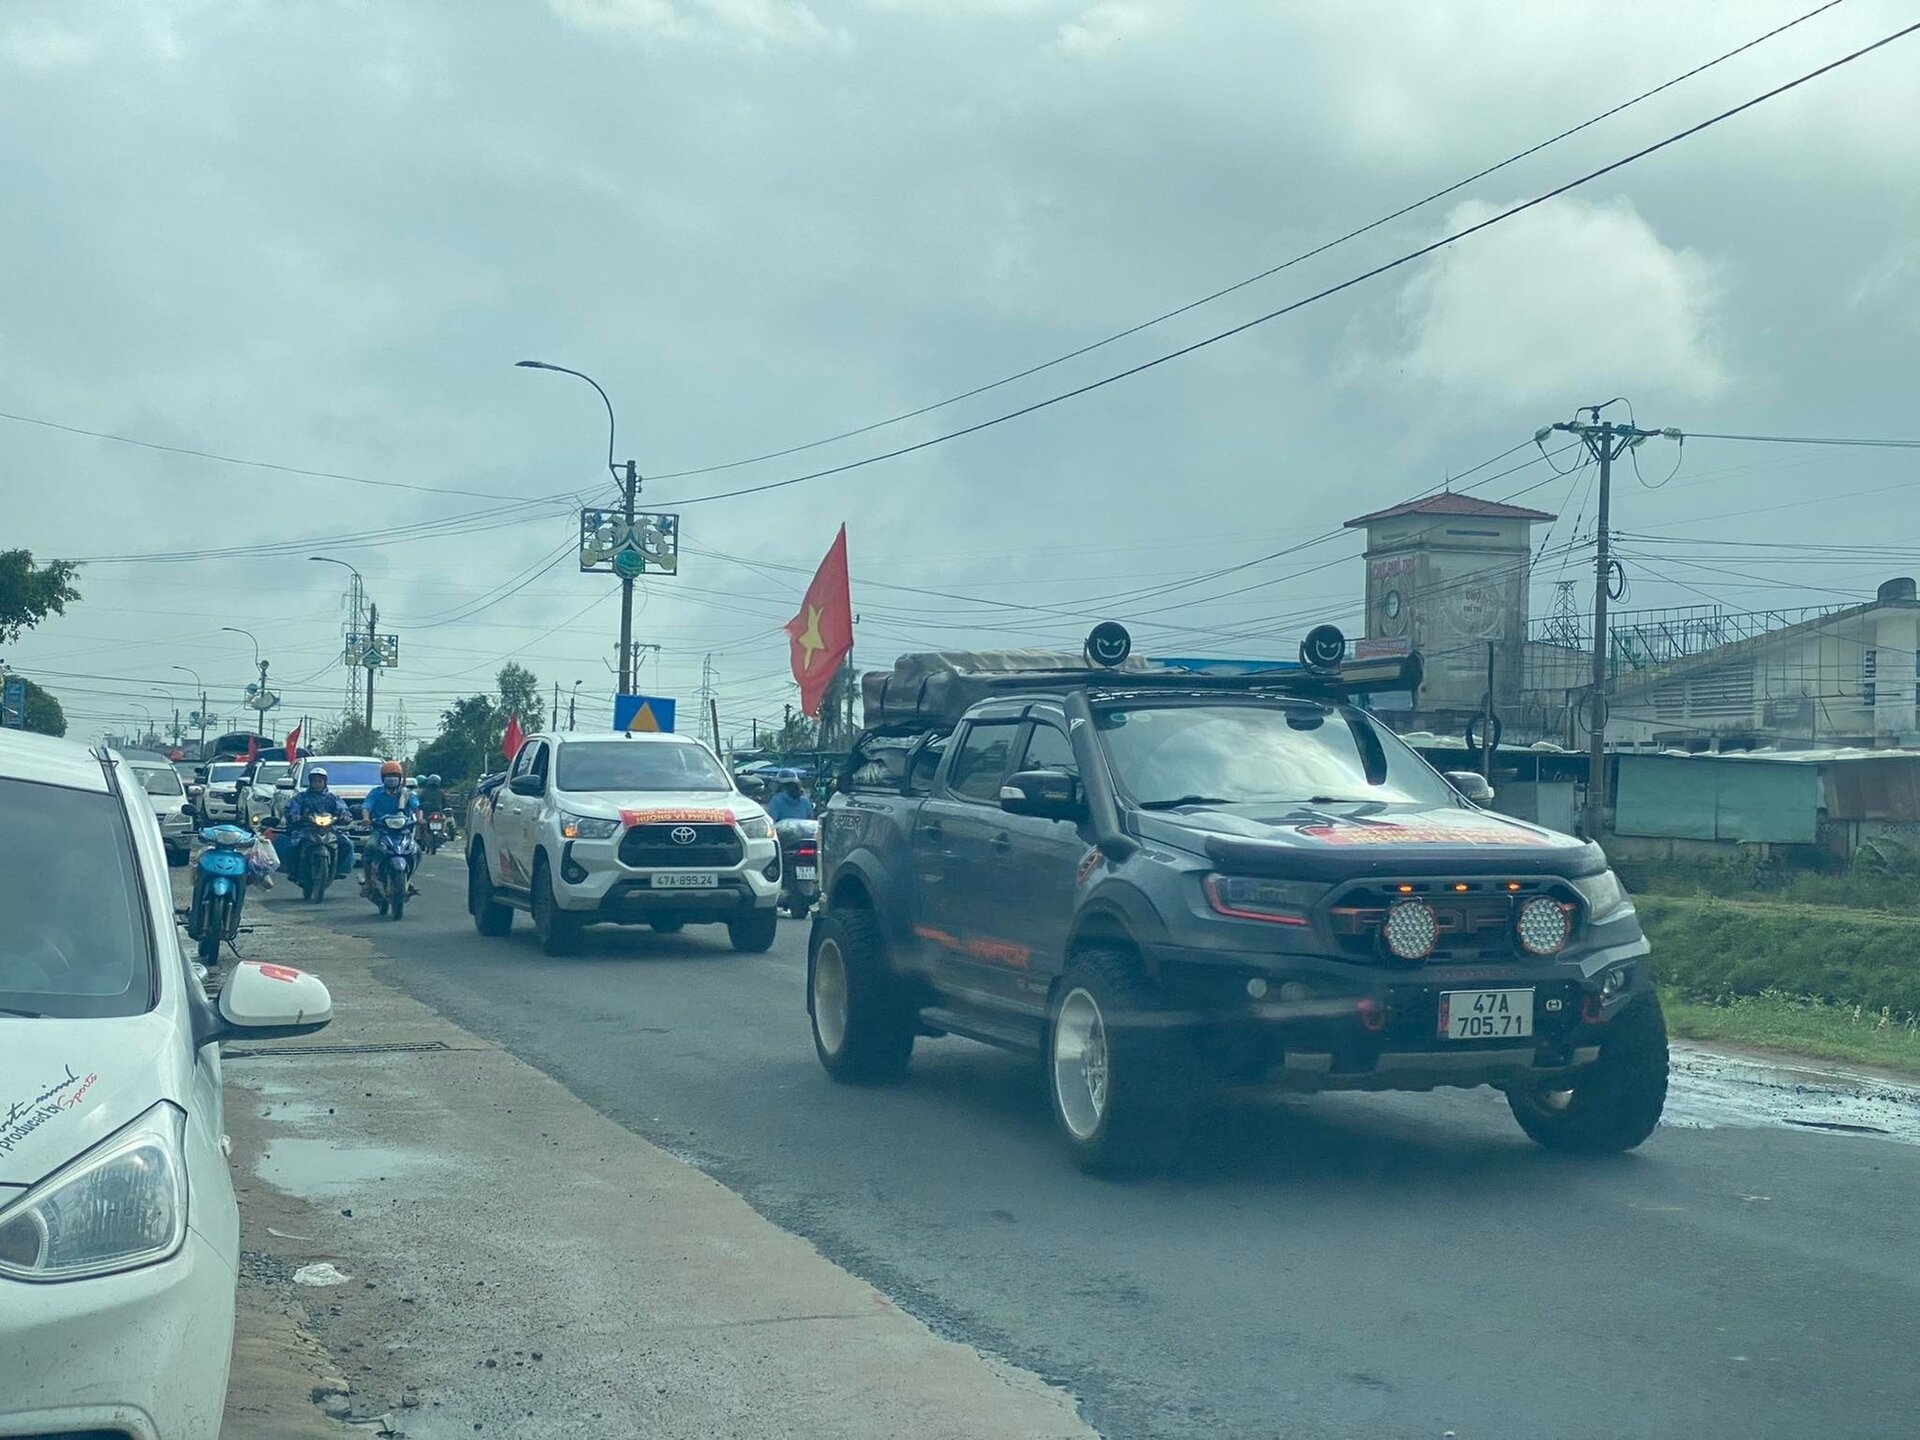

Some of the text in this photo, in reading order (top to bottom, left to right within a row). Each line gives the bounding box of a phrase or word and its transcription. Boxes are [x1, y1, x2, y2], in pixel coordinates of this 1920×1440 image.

[1473, 994, 1509, 1014] 47A
[1458, 1015, 1522, 1037] 705.71
[0, 1072, 97, 1152] produced by Sports
